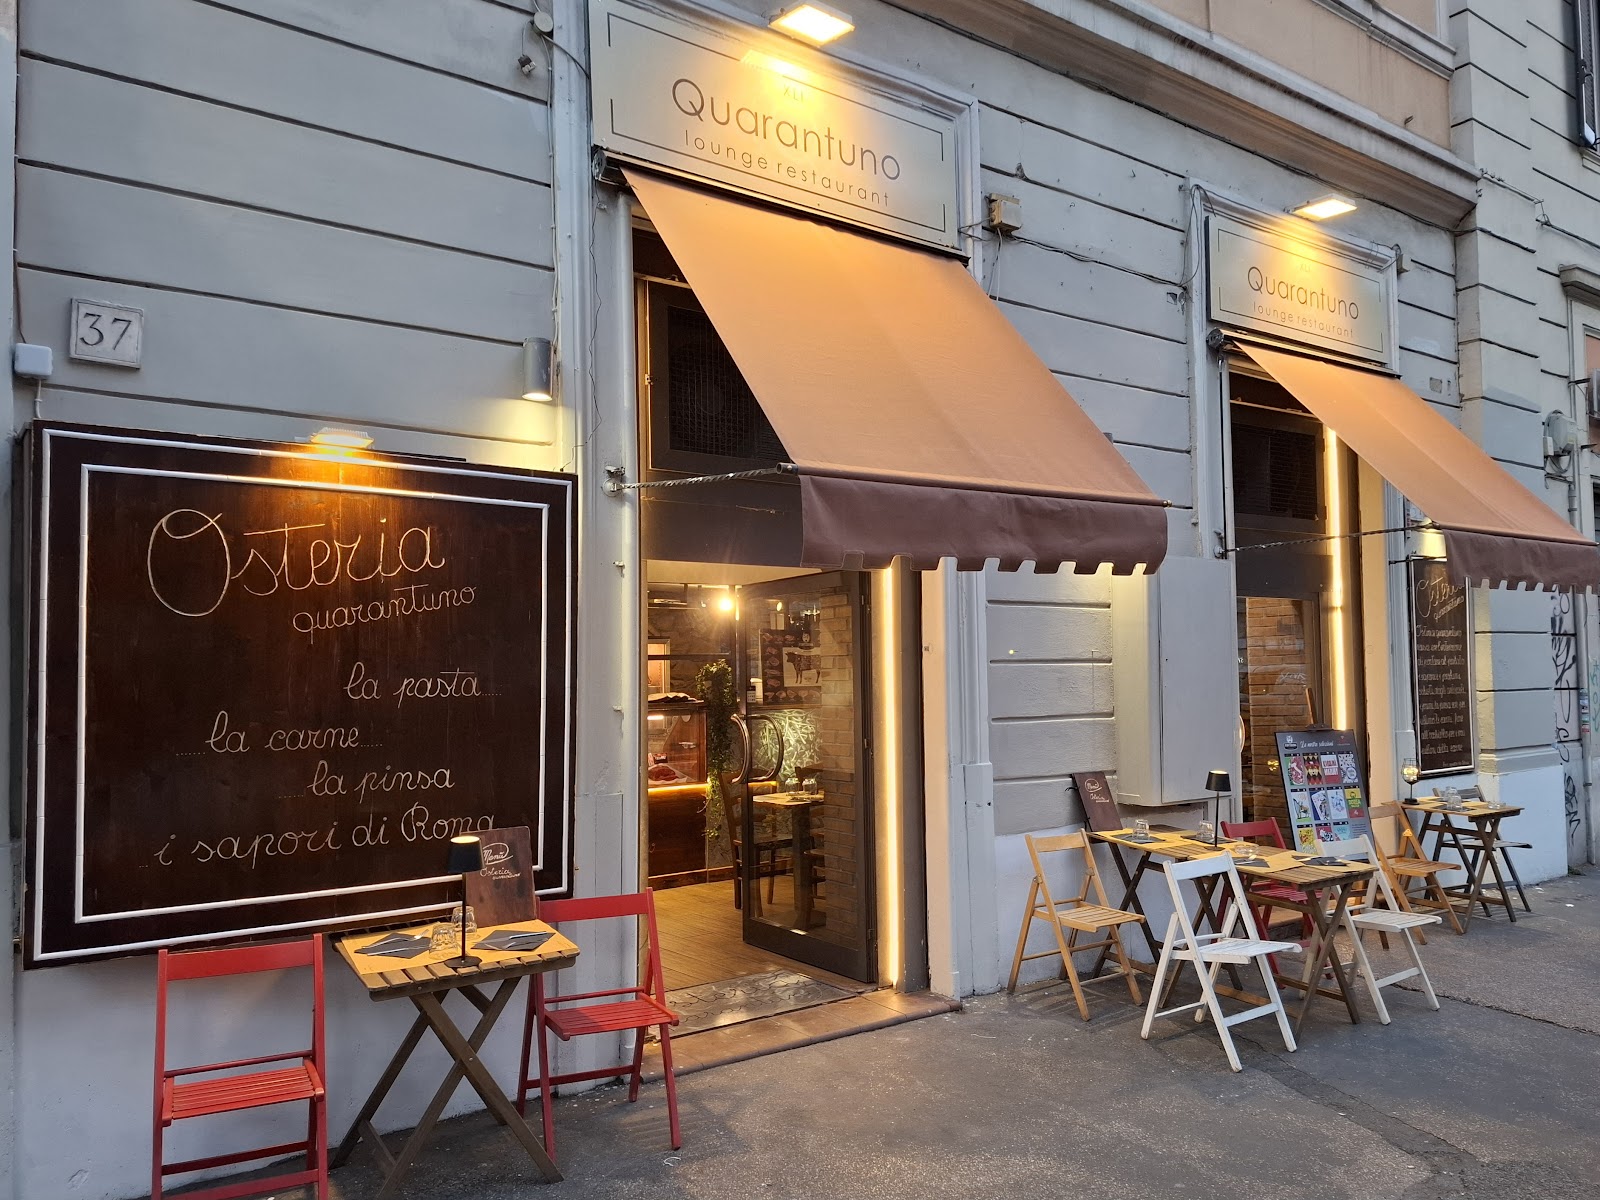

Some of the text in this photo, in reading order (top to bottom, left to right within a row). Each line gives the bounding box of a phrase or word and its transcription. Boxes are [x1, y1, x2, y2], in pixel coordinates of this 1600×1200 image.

[671, 78, 901, 181] Quarantuno
[684, 129, 890, 207] lounge restaurant
[1247, 266, 1360, 320] Quarantuno
[1253, 301, 1354, 337] lounge restaurant
[79, 312, 132, 351] 37
[147, 508, 446, 617] Osteria
[292, 583, 478, 645] quarantuno
[343, 661, 381, 700] la
[353, 764, 456, 804] pinsa
[153, 833, 177, 866] i
[191, 820, 343, 870] sapori
[352, 811, 390, 847] di
